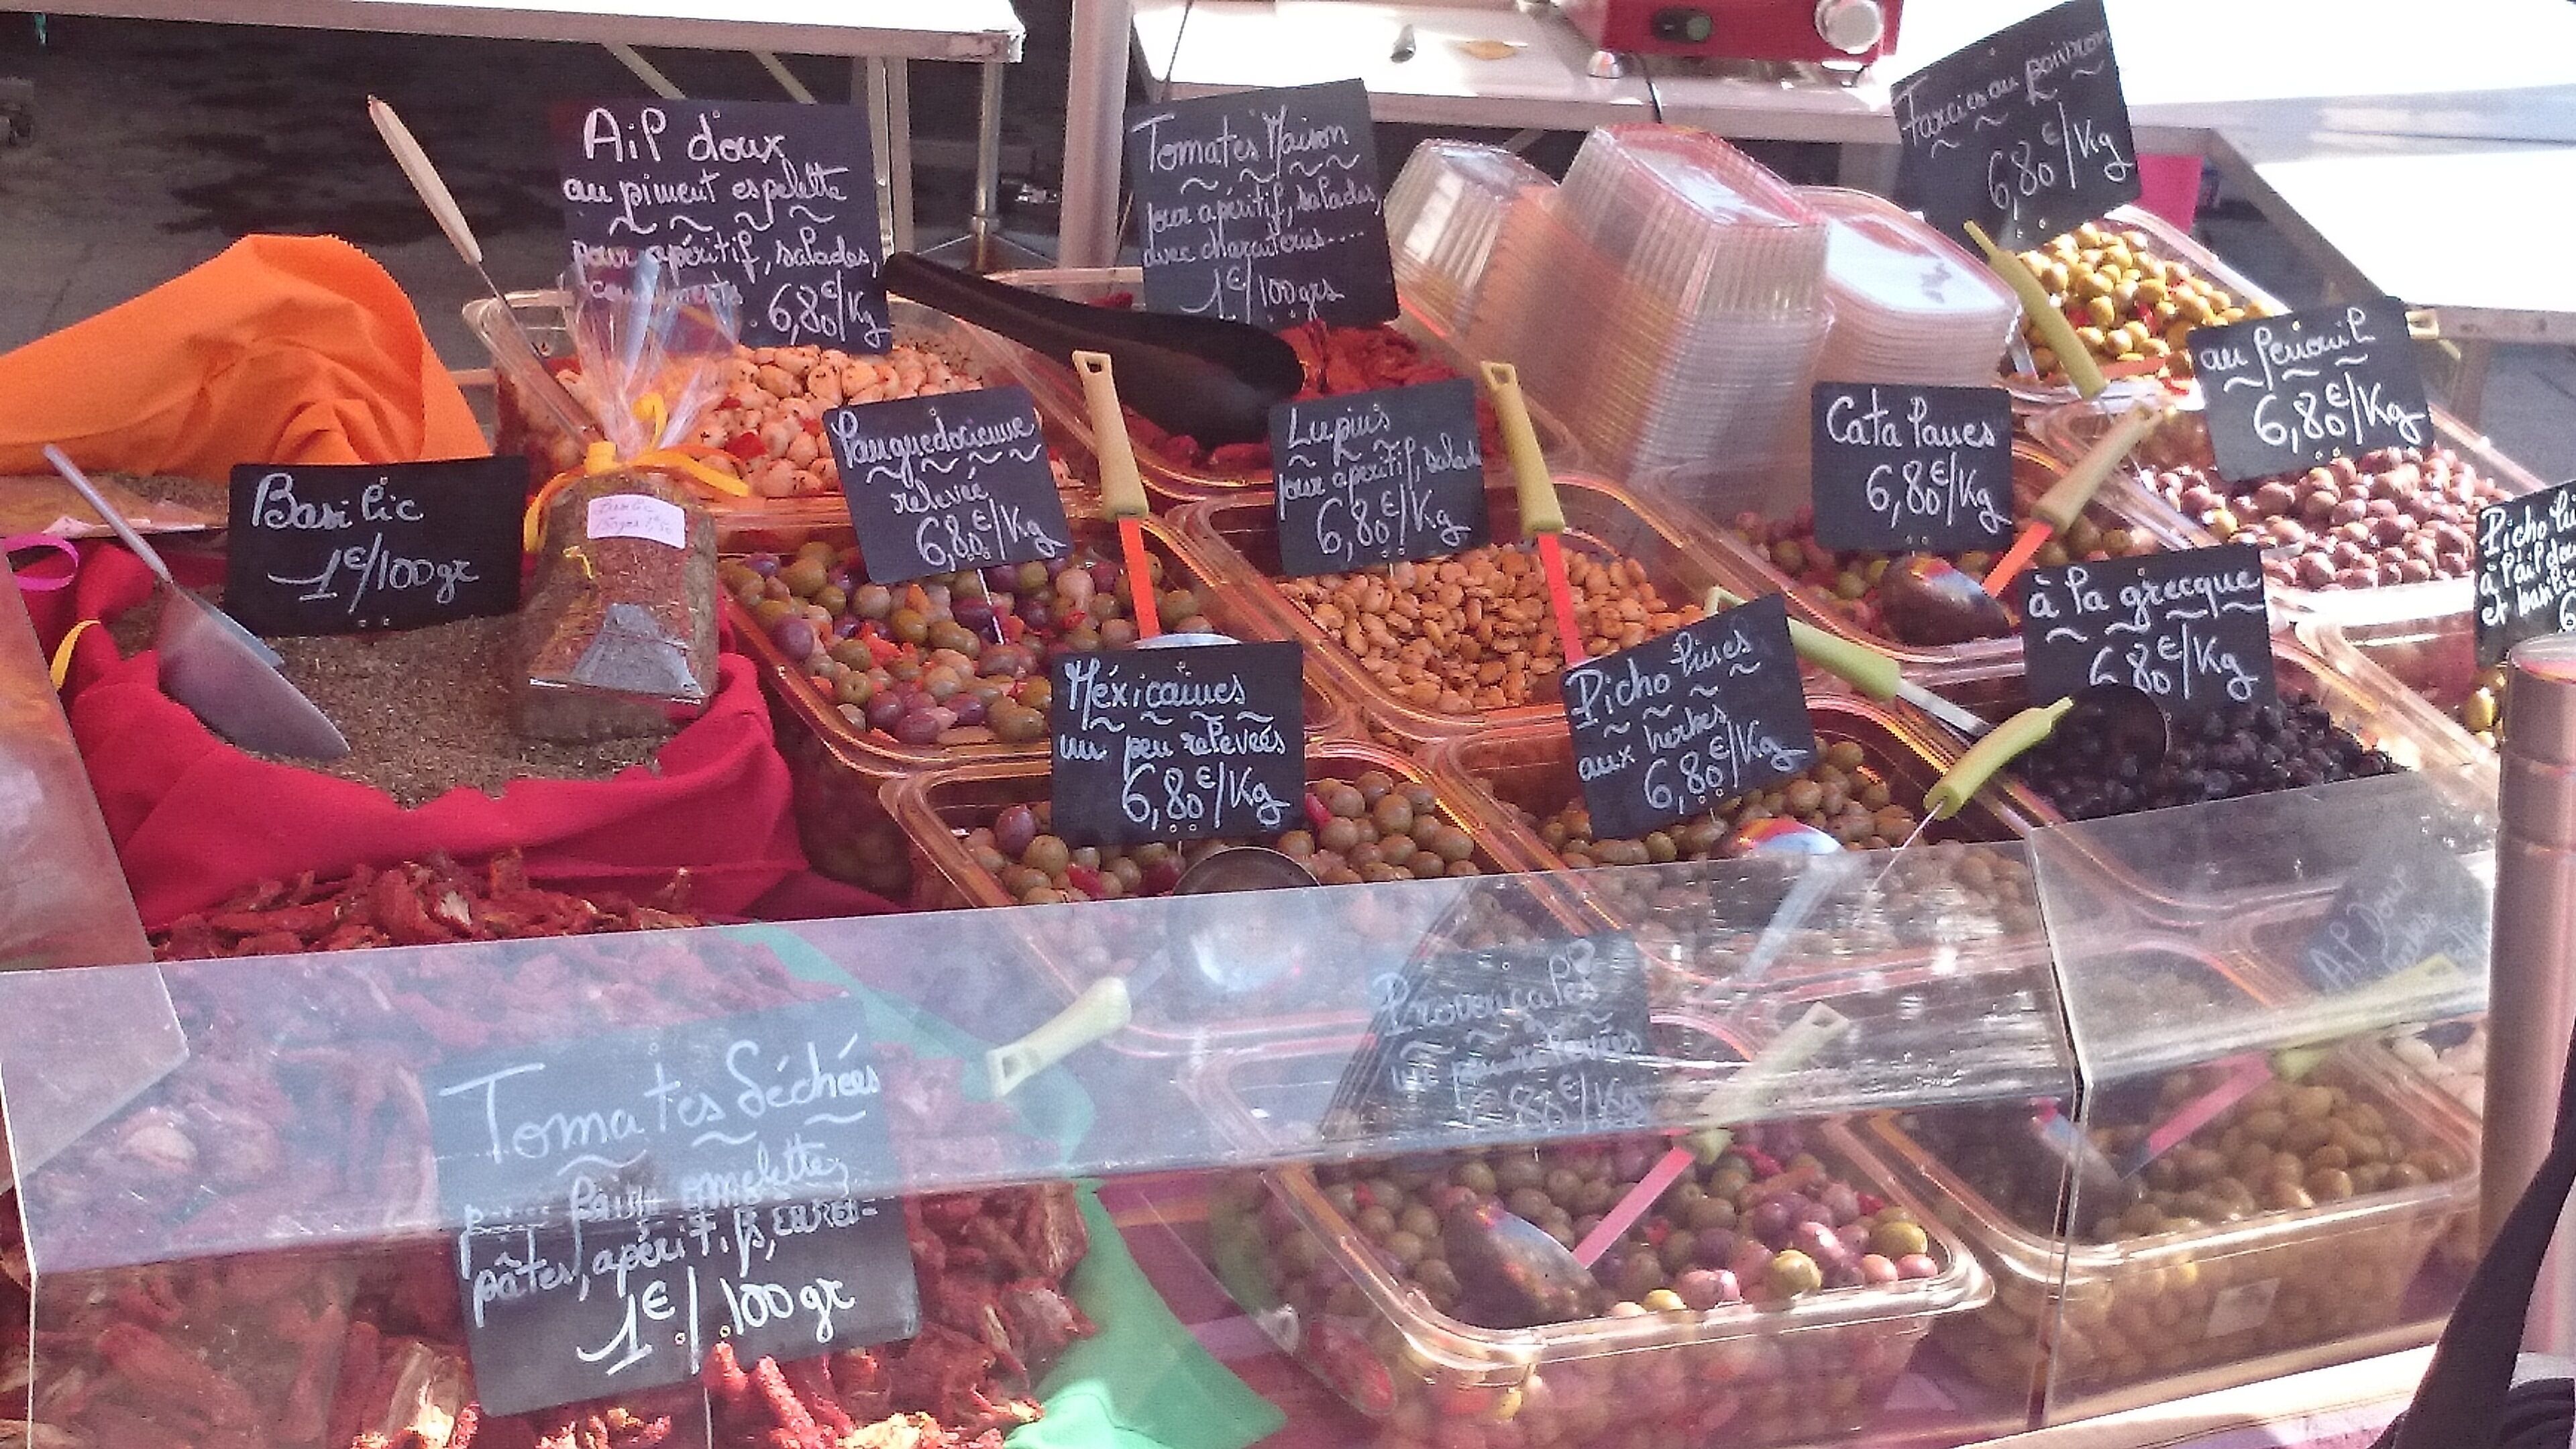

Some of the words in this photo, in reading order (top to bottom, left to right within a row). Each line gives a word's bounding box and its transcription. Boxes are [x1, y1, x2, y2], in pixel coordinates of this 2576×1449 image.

[688, 113, 786, 164] doux
[1132, 113, 1260, 173] Tomates
[563, 178, 612, 203] au
[2201, 349, 2249, 371] au
[2254, 307, 2375, 390] fenouil
[2119, 570, 2261, 630] grecque
[1578, 745, 1636, 782] aux
